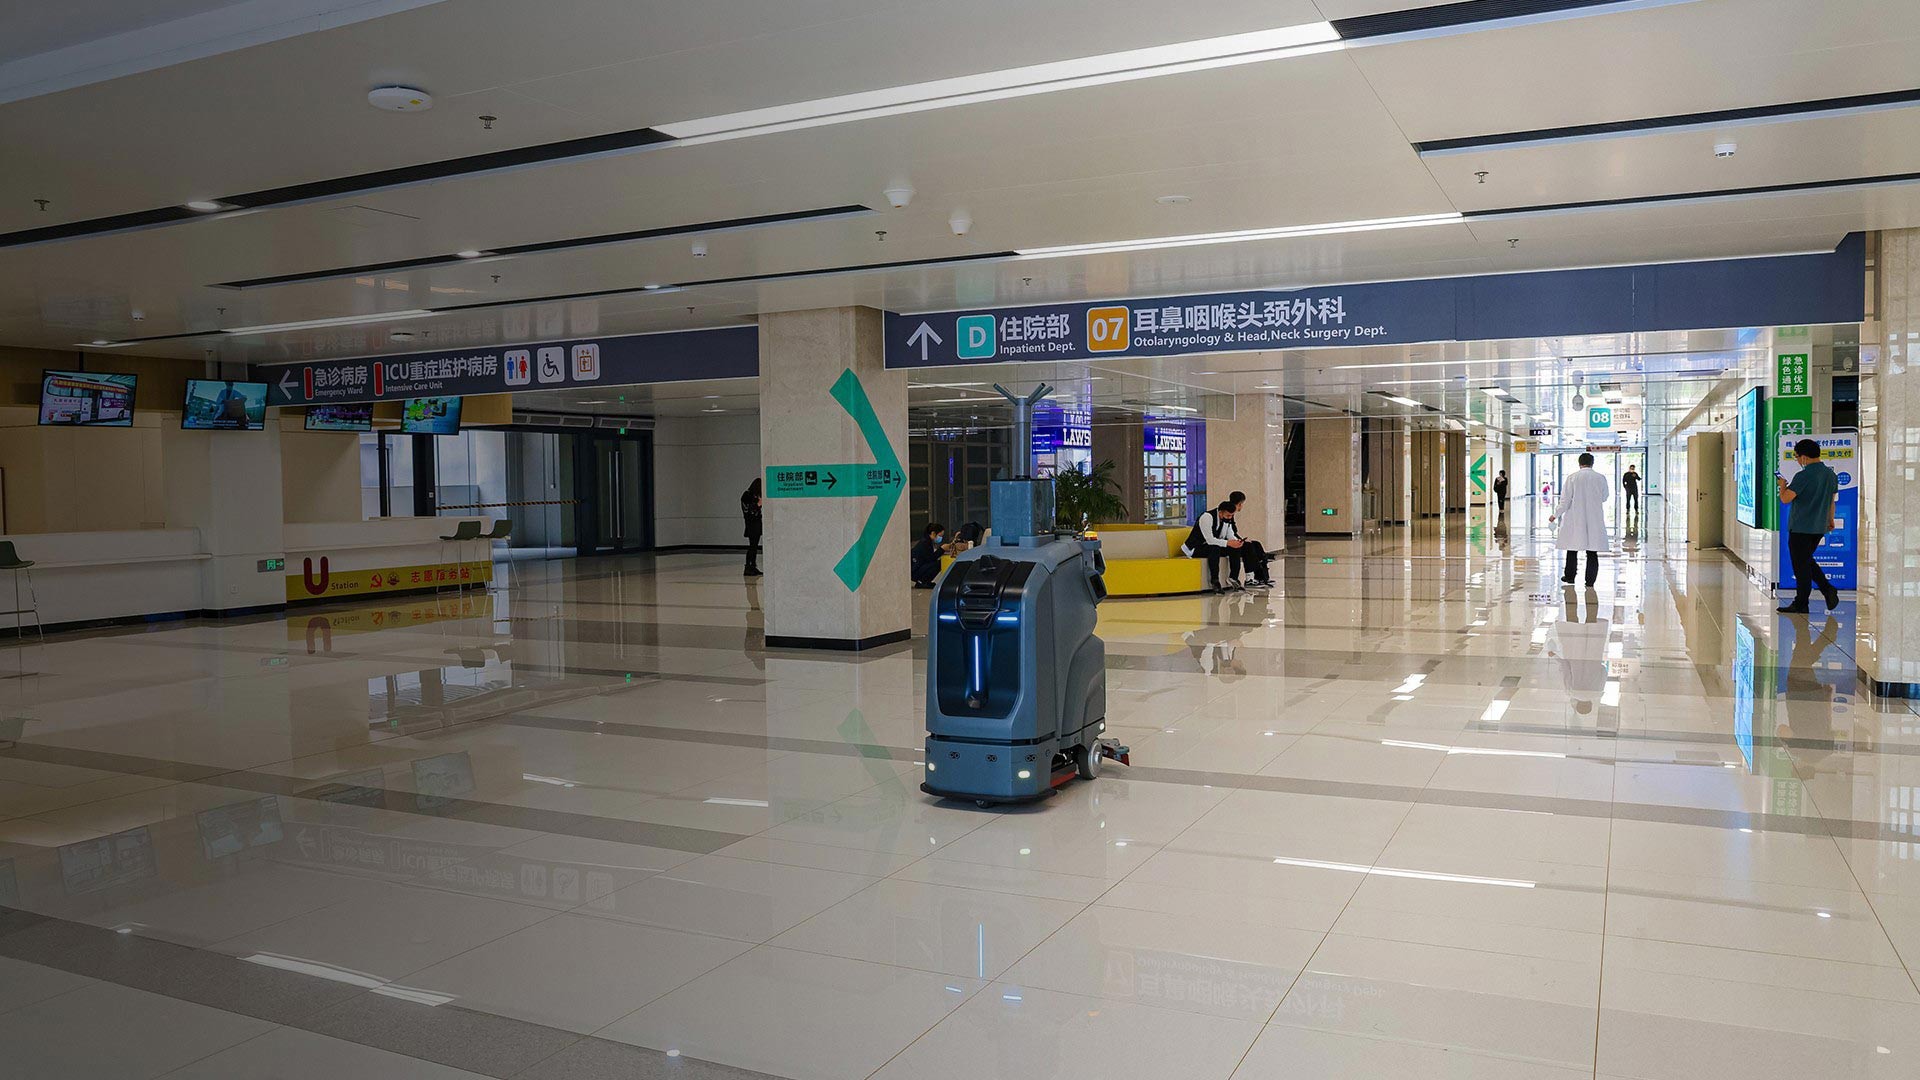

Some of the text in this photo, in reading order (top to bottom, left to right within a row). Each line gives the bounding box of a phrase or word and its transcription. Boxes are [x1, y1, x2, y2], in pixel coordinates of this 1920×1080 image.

[1133, 296, 1347, 335] 耳鼻咽喉头颈外科
[968, 326, 987, 348] D
[999, 313, 1071, 342] 住院部
[1091, 317, 1125, 342] 07
[1133, 334, 1221, 348] Otolaryngology
[1223, 332, 1235, 343] &
[1303, 327, 1350, 342] Surgery
[1354, 325, 1388, 339] Dept.
[999, 341, 1076, 356] Inpatient Dept.
[314, 365, 368, 387] 急诊病房
[385, 355, 498, 381] ICU重症监护病房
[1793, 356, 1804, 393] 急诊优先
[314, 386, 363, 398] Emergency Ward
[385, 380, 443, 393] Intensive Care Unit
[1592, 412, 1609, 423] 08
[1155, 434, 1183, 451] LAWSON
[303, 556, 359, 596] U Station
